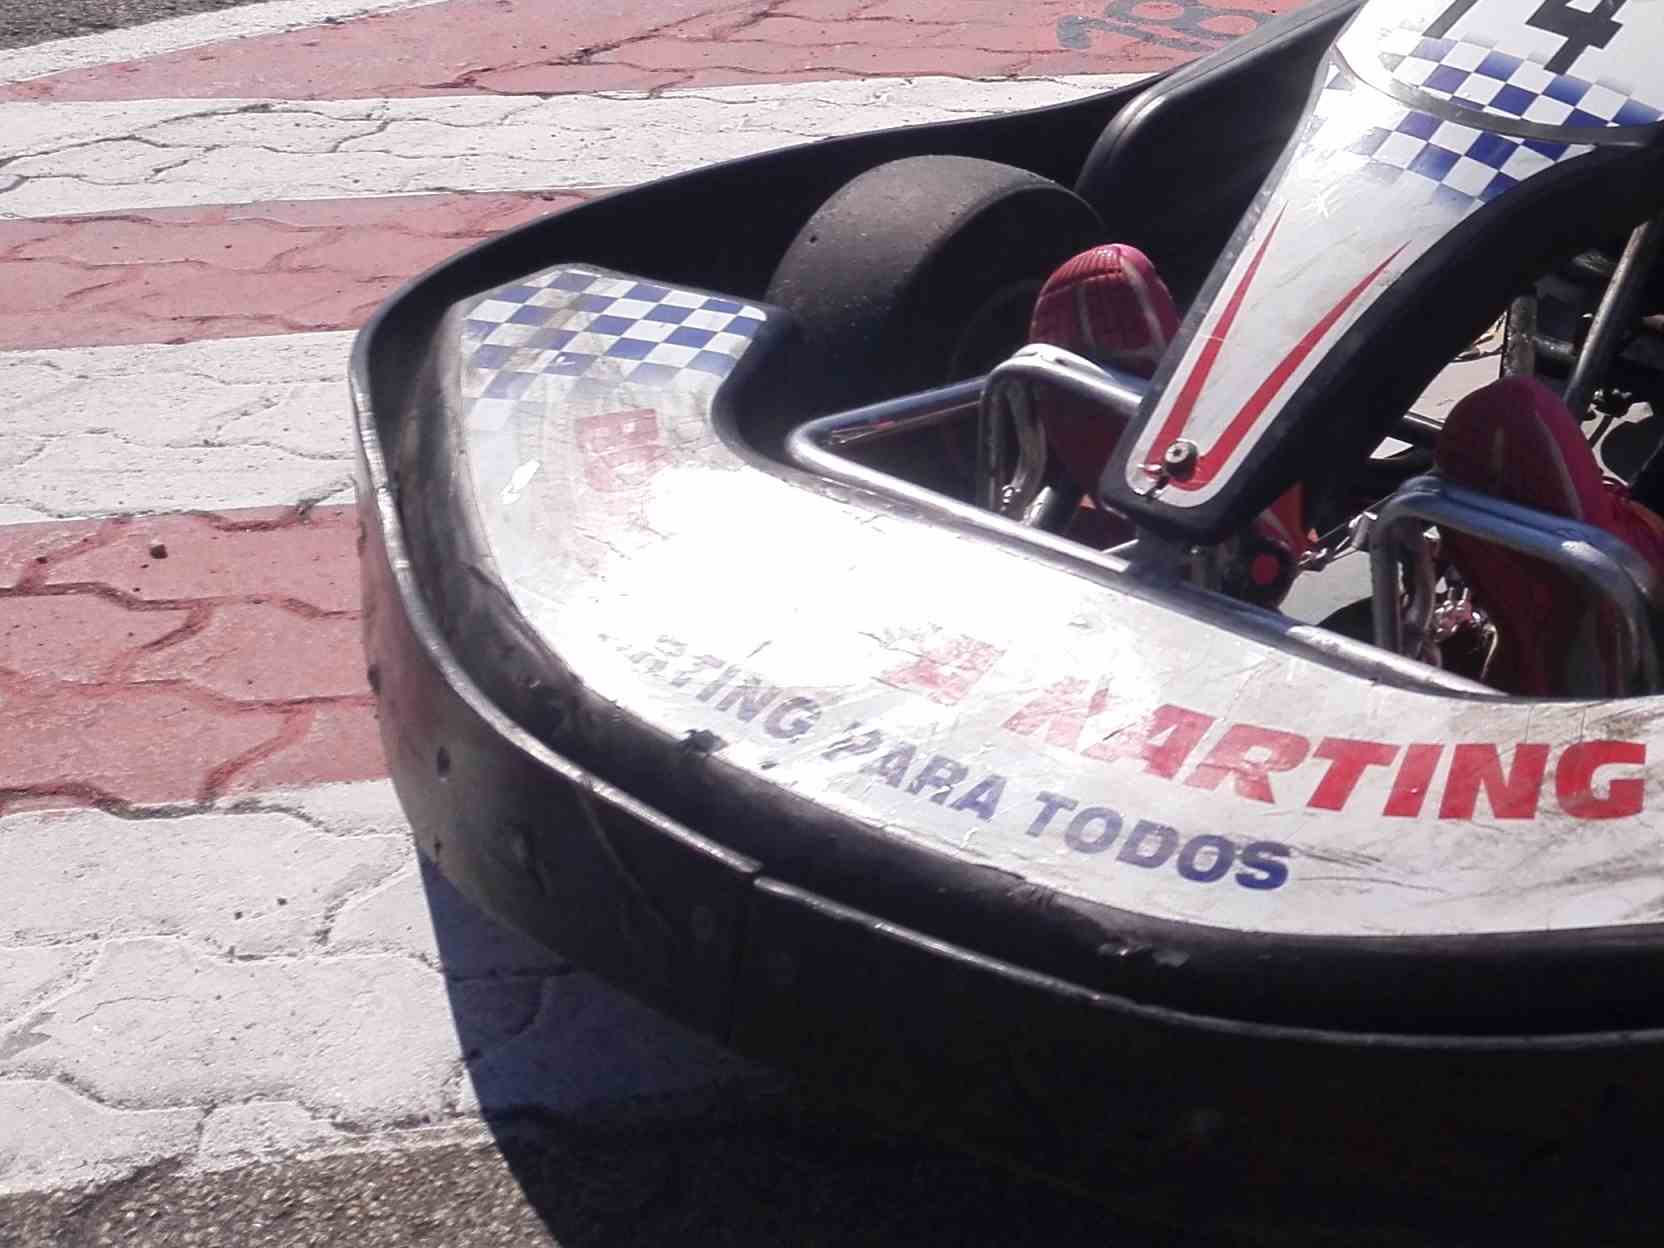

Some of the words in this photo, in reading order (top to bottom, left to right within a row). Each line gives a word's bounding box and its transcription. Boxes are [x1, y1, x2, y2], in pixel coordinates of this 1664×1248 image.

[820, 724, 1008, 821] PARA
[1024, 790, 1292, 891] TODOS
[1001, 675, 1648, 822] KARTING
